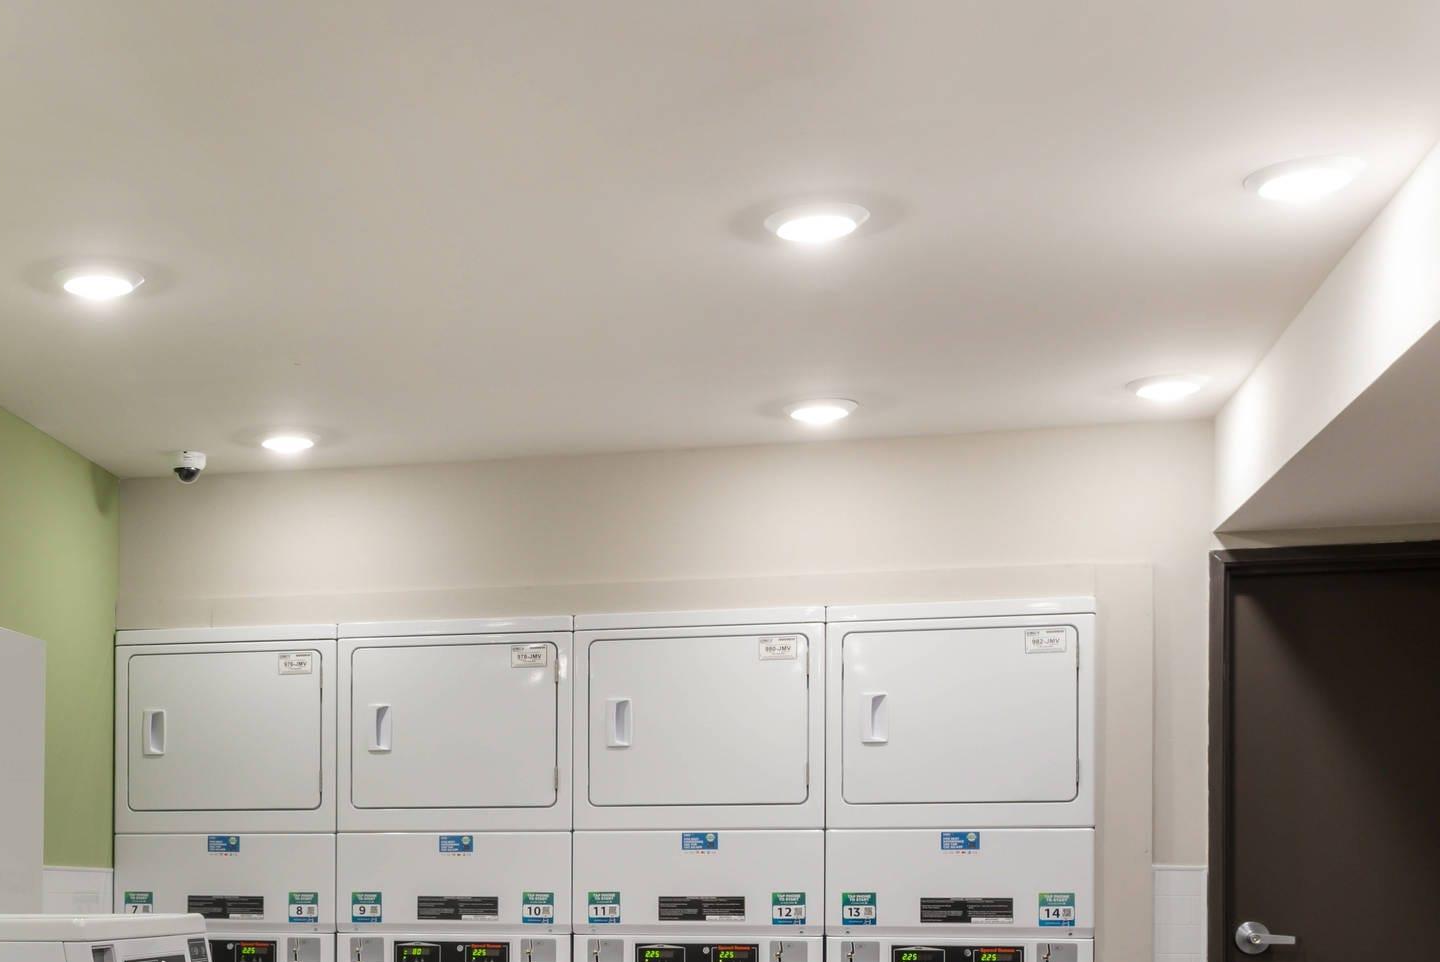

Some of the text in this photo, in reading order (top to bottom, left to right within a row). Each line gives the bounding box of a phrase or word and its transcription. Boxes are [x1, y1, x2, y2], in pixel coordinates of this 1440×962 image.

[132, 905, 138, 914] 7
[296, 906, 303, 916] 8
[359, 905, 366, 915] 9
[527, 906, 541, 916] 10
[594, 906, 606, 916] 11
[777, 907, 792, 917] 12
[848, 907, 861, 917] 13
[1045, 908, 1060, 918] 14
